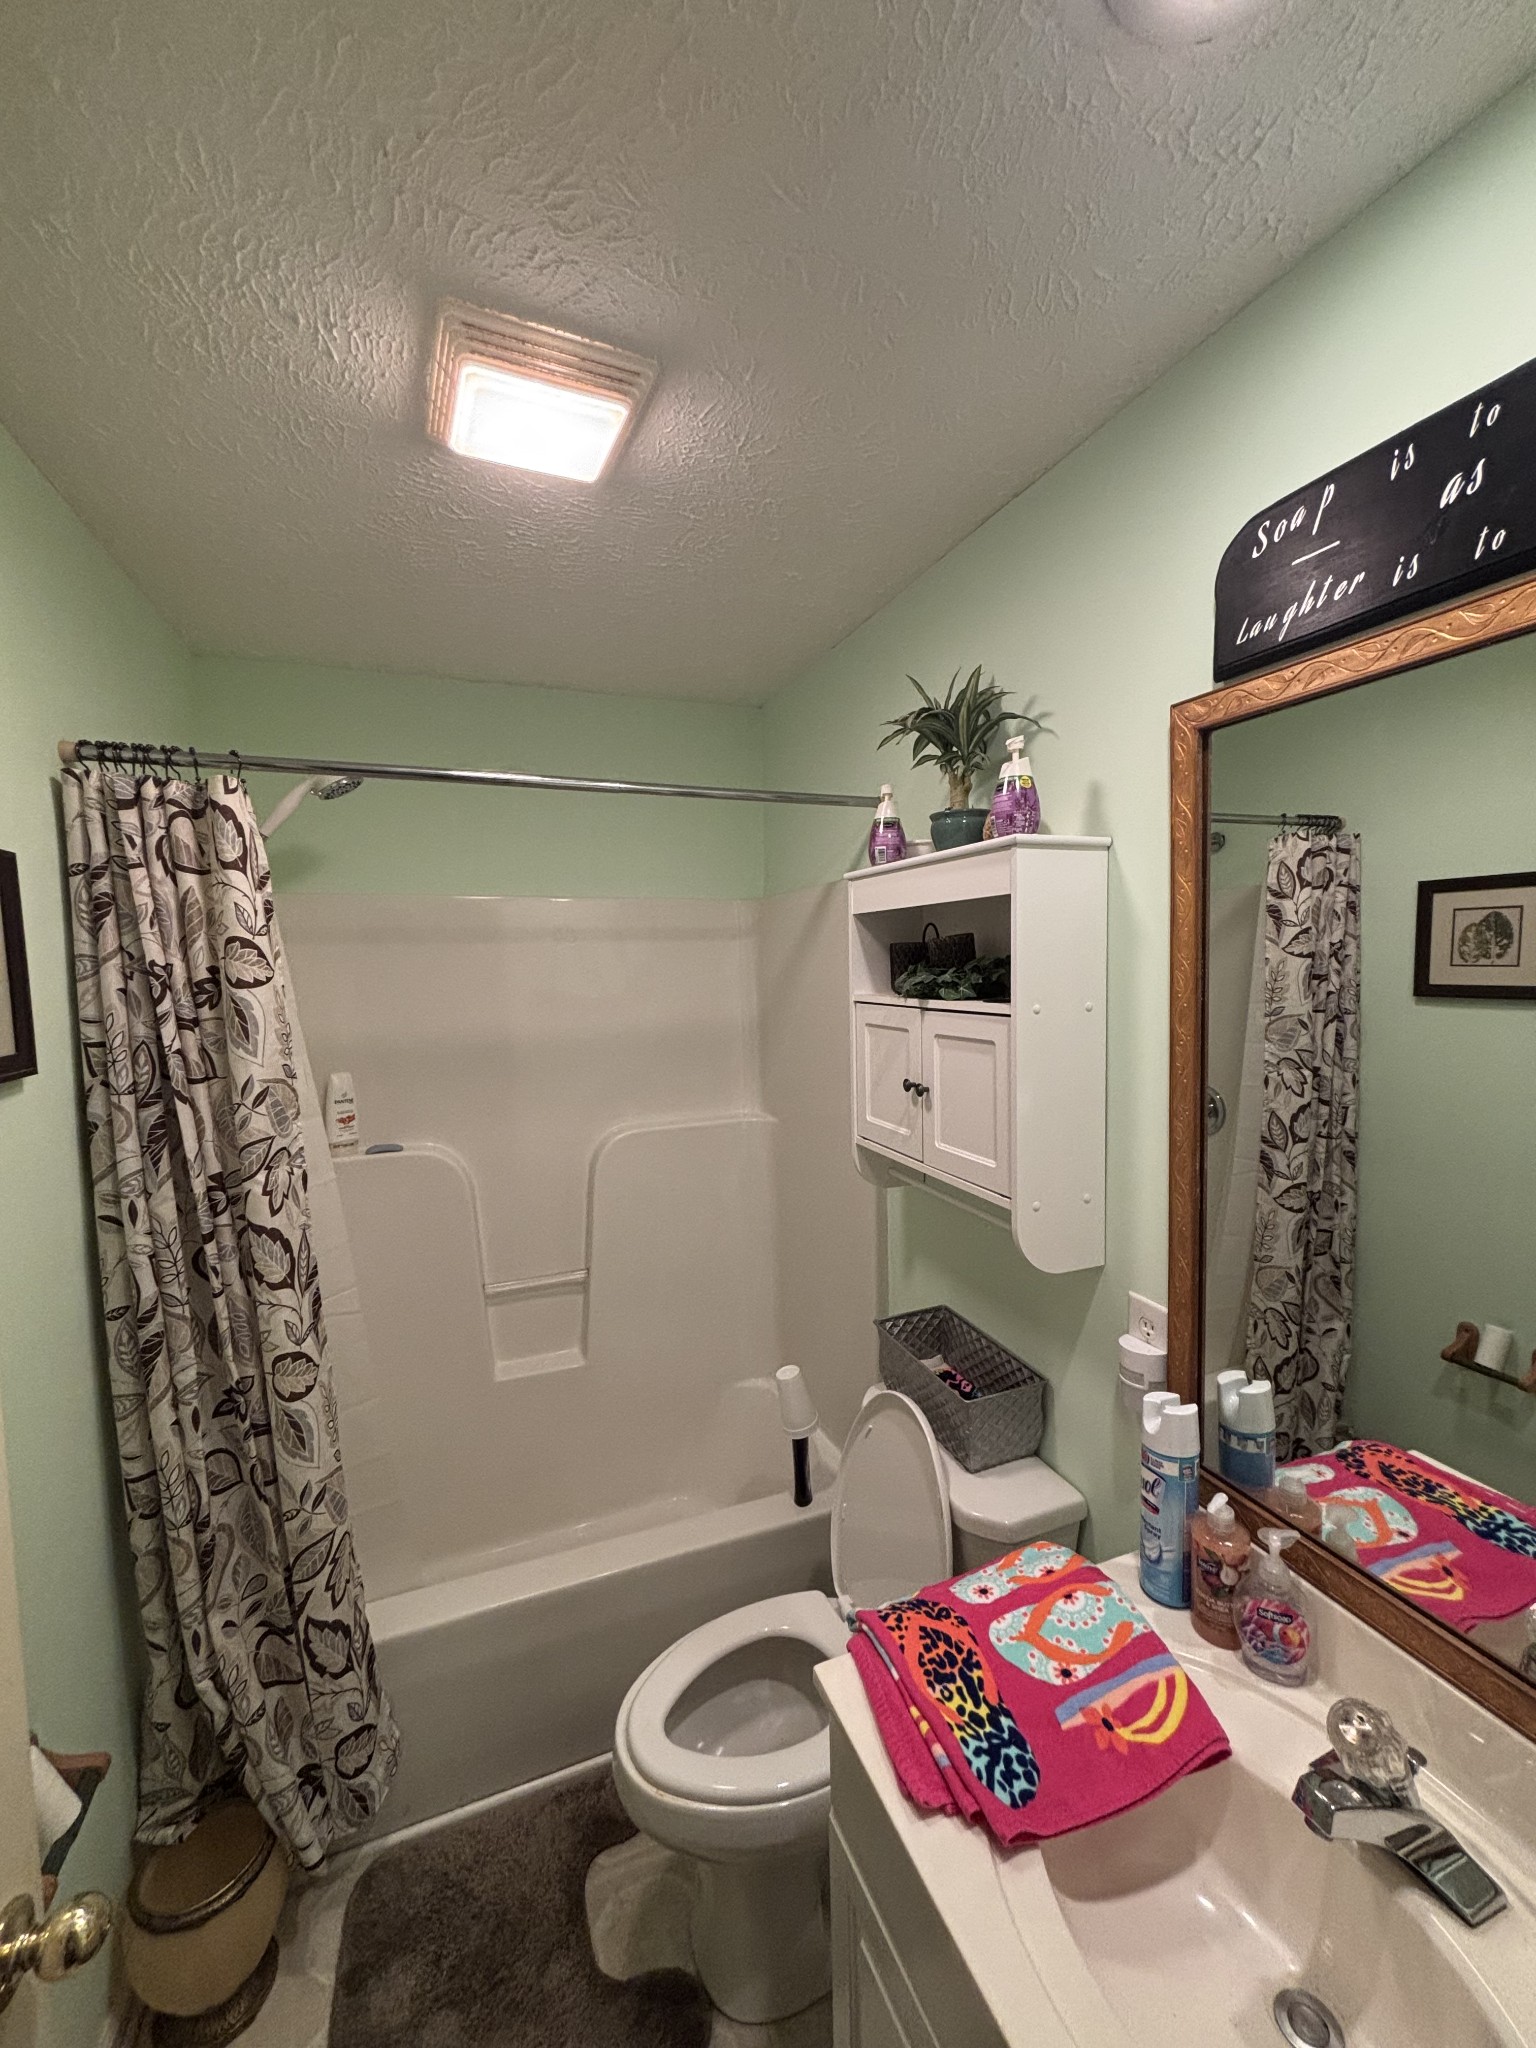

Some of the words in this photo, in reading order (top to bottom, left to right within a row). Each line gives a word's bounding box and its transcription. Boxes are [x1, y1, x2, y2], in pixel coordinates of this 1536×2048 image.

[1252, 483, 1335, 558] Soap
[1390, 443, 1415, 480] is
[1469, 402, 1501, 438] to
[1439, 458, 1486, 509] as
[1392, 553, 1420, 587] is
[1474, 526, 1507, 560] to
